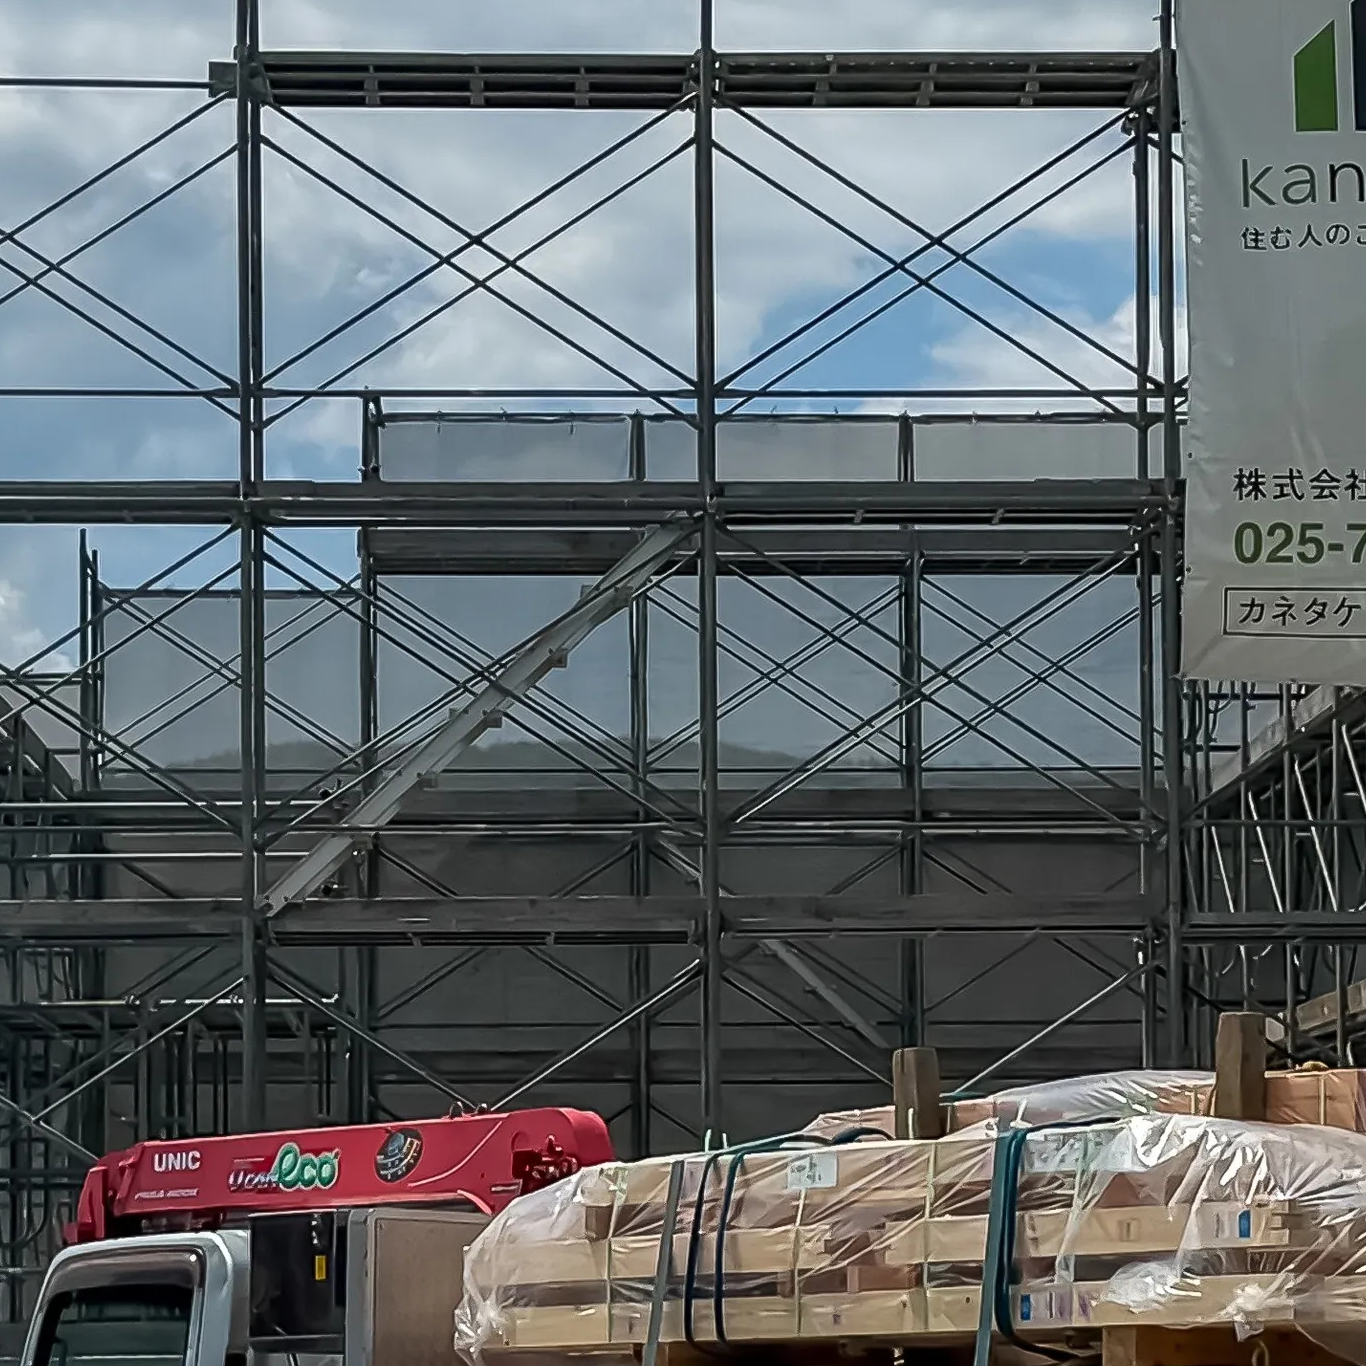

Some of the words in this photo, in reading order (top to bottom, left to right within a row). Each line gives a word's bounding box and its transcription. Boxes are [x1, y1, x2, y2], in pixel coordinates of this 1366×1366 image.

[1238, 595, 1362, 628] カネタケ
[153, 1151, 202, 1173] UNIC
[274, 1142, 342, 1192] eco
